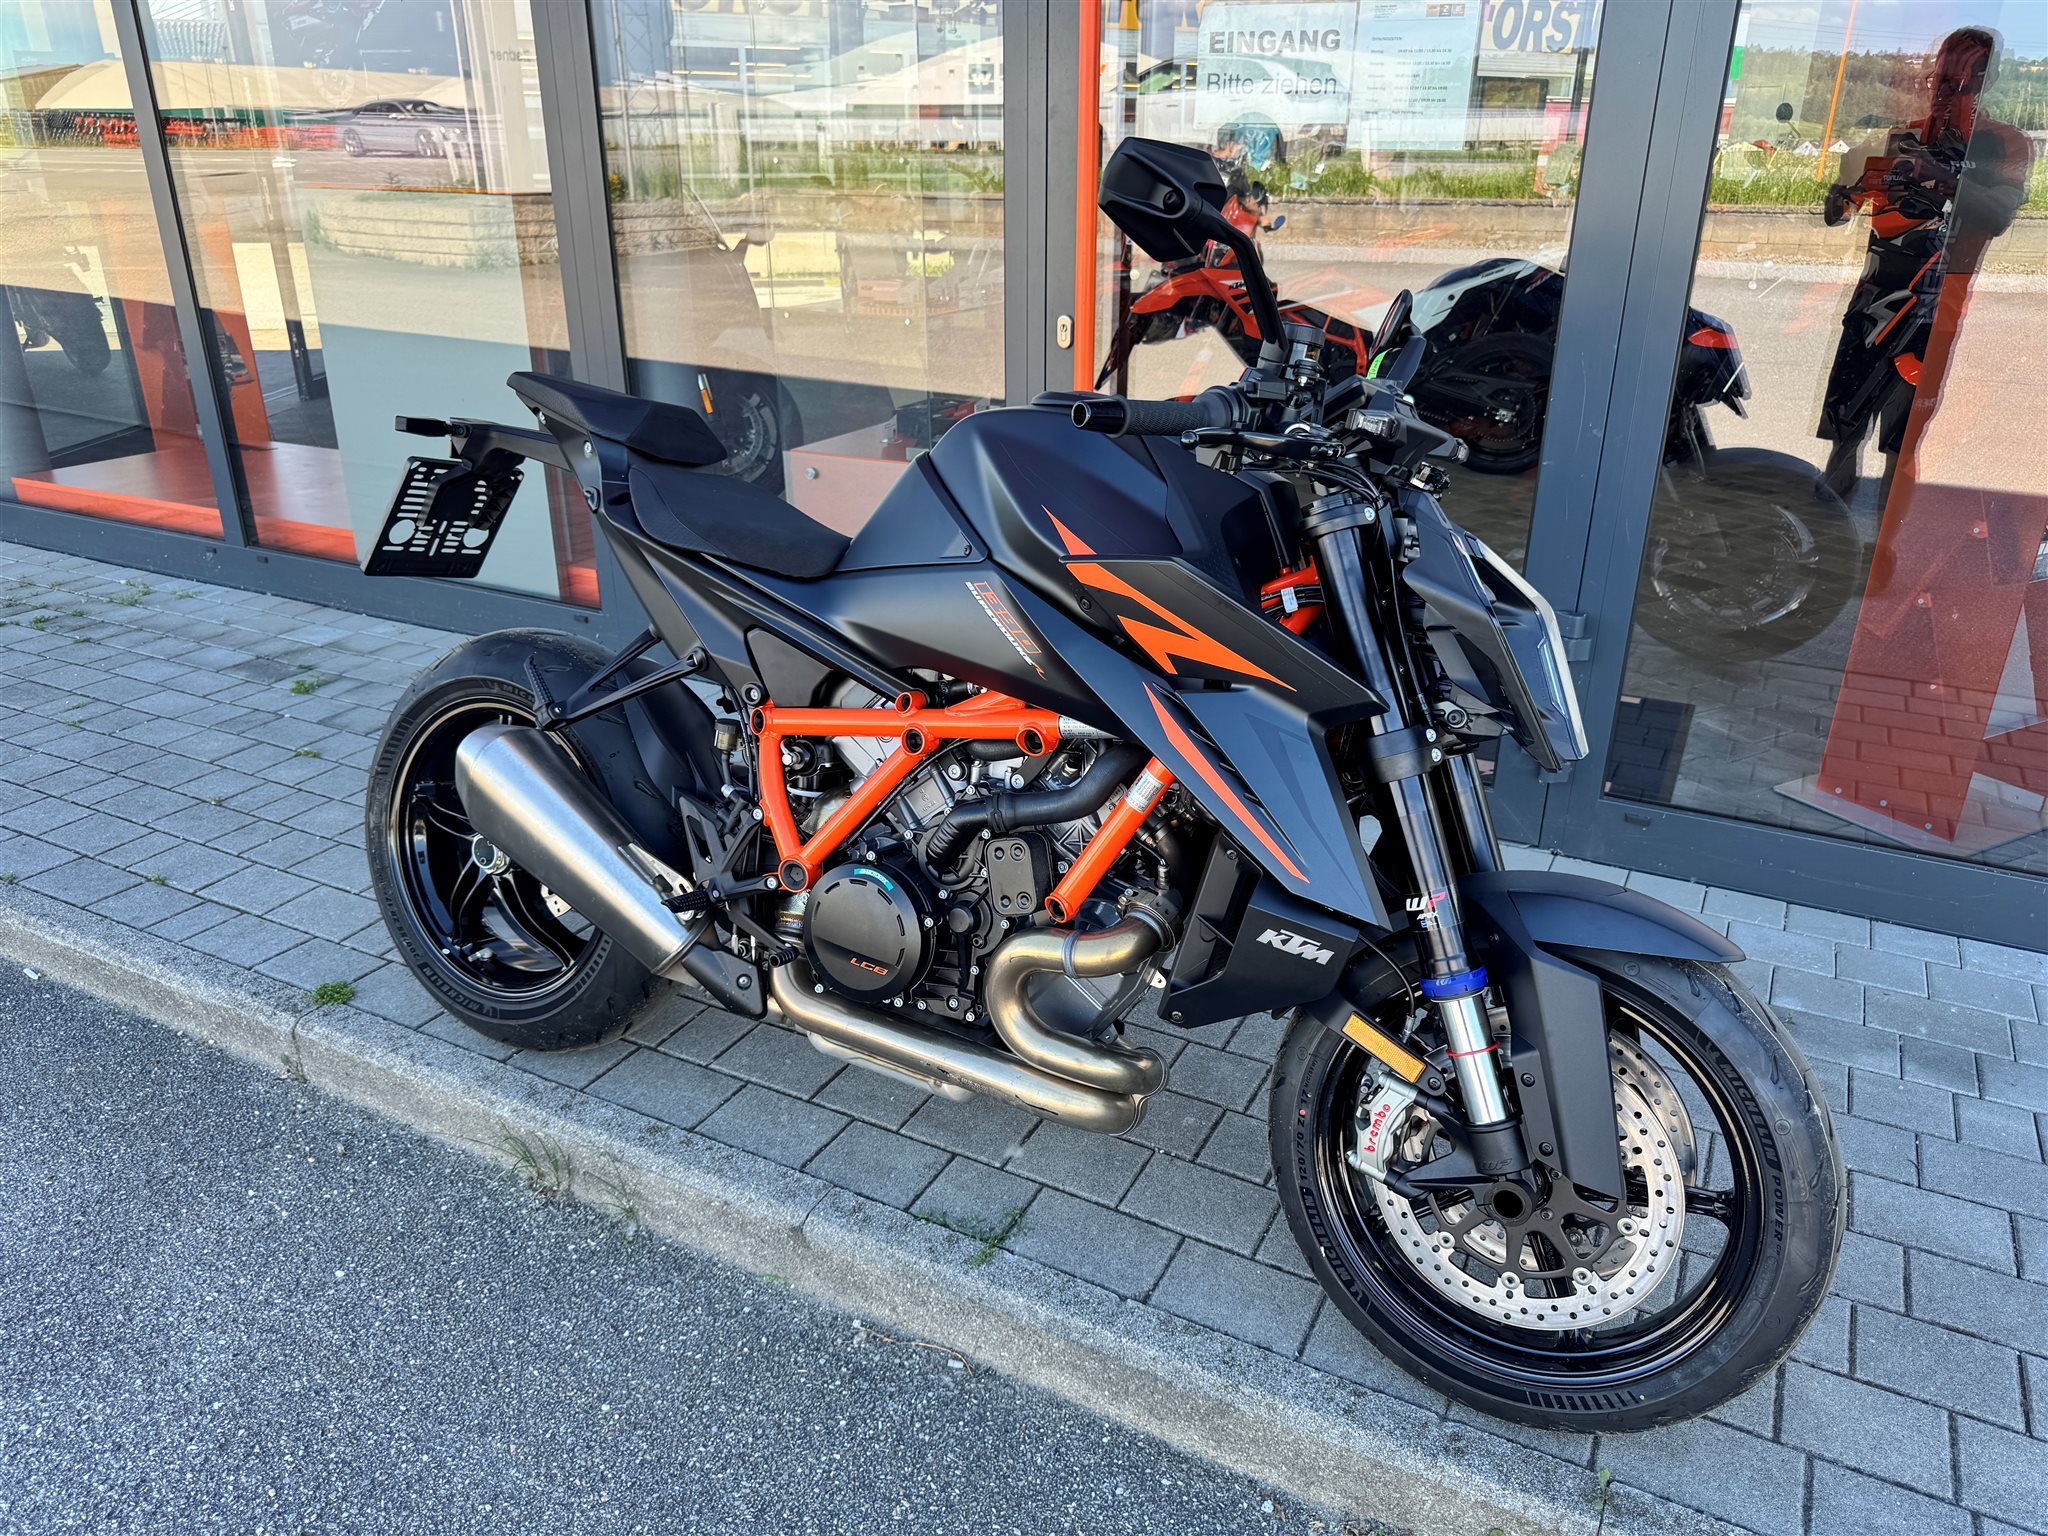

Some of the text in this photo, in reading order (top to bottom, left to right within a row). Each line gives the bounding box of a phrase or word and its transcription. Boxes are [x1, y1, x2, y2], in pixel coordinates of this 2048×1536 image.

[1209, 29, 1341, 54] EINGANG
[1206, 72, 1338, 95] Bitte ziehen
[1406, 891, 1446, 911] WP
[850, 957, 889, 976] LC8
[1256, 928, 1335, 966] KTM
[423, 966, 480, 1011] MICHELIN
[1363, 1103, 1392, 1154] brembo
[1297, 1131, 1308, 1182] 120/70
[1720, 1062, 1778, 1170] MICHELIN
[1772, 1174, 1785, 1244] POWER
[1304, 1192, 1350, 1285] MICHELIN
